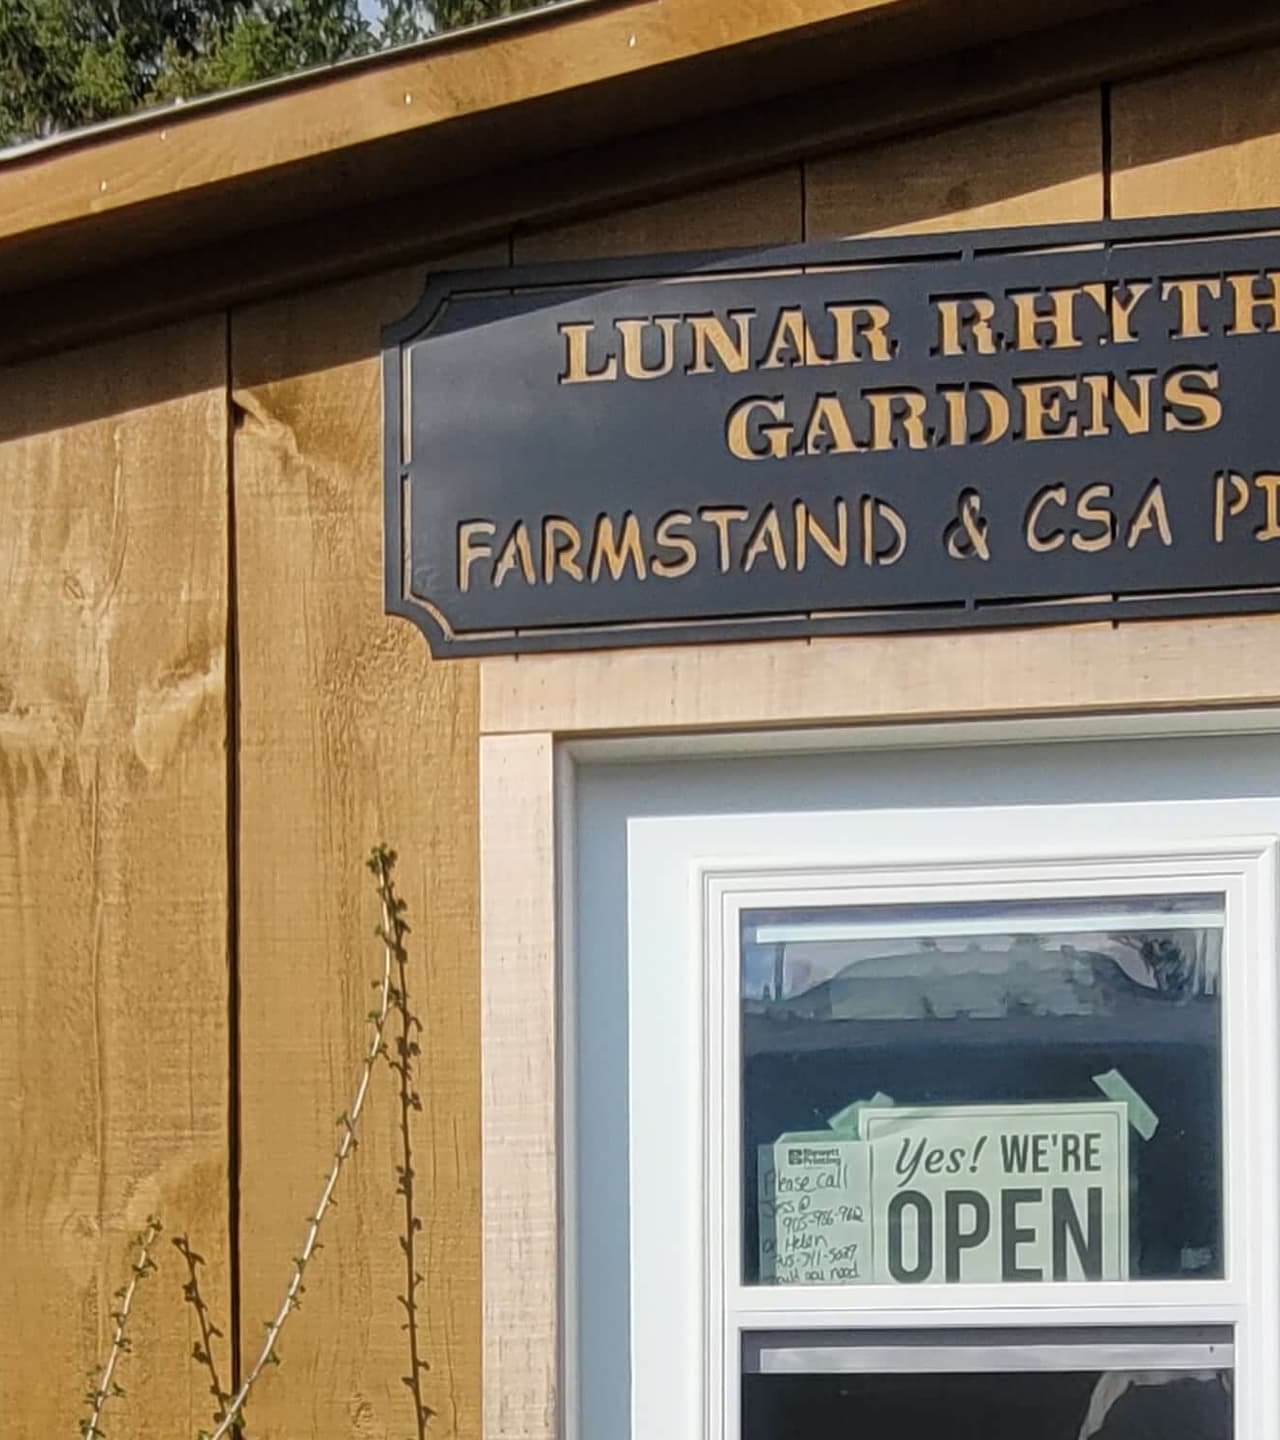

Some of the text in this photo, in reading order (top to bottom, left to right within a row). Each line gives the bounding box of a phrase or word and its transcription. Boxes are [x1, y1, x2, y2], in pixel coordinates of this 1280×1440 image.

[557, 302, 898, 385] LUNAR
[724, 363, 1223, 462] GARDENS
[456, 495, 908, 593] FARMSTAND
[943, 487, 991, 562] &
[1024, 478, 1173, 554] CSA
[895, 1132, 1102, 1188] Yes! WE'RE
[887, 1187, 1103, 1283] OPEN
